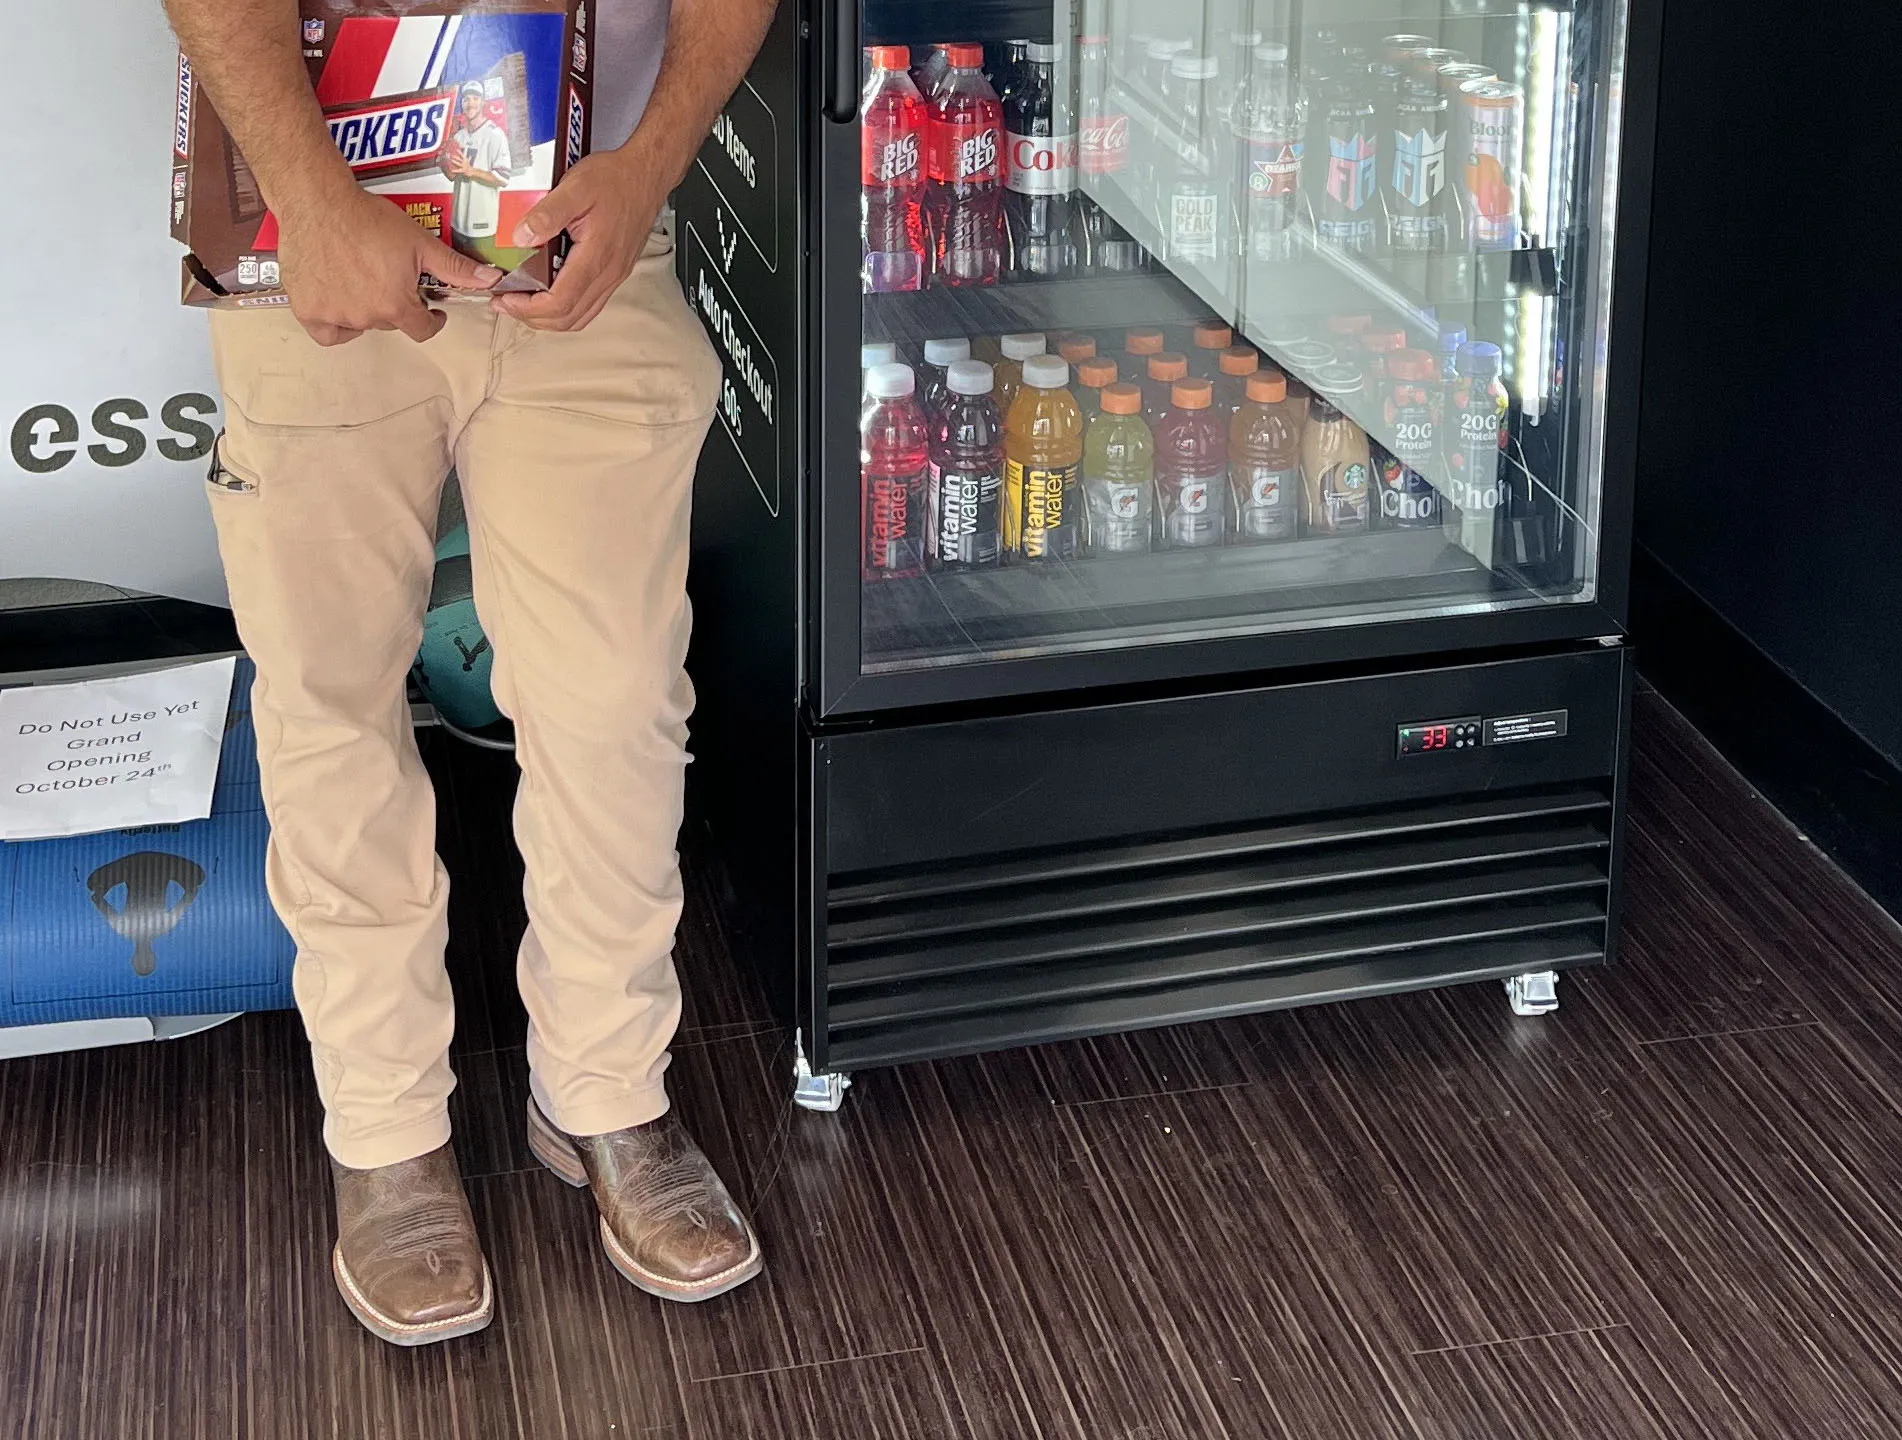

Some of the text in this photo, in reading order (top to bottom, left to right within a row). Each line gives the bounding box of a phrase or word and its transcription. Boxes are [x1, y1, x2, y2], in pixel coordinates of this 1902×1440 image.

[174, 57, 191, 153] SNICKERS
[330, 103, 446, 162] ICKERS
[883, 132, 916, 161] BIG
[962, 127, 994, 160] BIG
[726, 114, 756, 189] Items
[880, 148, 919, 182] RED
[959, 145, 997, 178] RED
[1175, 198, 1213, 215] GOLD
[1175, 215, 1213, 233] PEAK
[239, 263, 257, 274] 250
[698, 267, 773, 425] Auto Checkout
[724, 377, 743, 437] 60s
[1460, 412, 1498, 431] 20G
[1394, 439, 1433, 451] Protein
[1395, 422, 1433, 441] 20G
[1460, 429, 1499, 442] Protein
[889, 481, 908, 540] water
[960, 478, 979, 536] water
[1022, 470, 1046, 558] vitamin
[1045, 471, 1063, 529] water
[871, 478, 889, 568] vitamin
[939, 474, 961, 562] vitamin
[18, 699, 201, 735] Do Not Use Yet
[66, 731, 143, 750] Grand
[1422, 724, 1448, 751] 33
[46, 749, 153, 773] Opening
[15, 774, 120, 795] October
